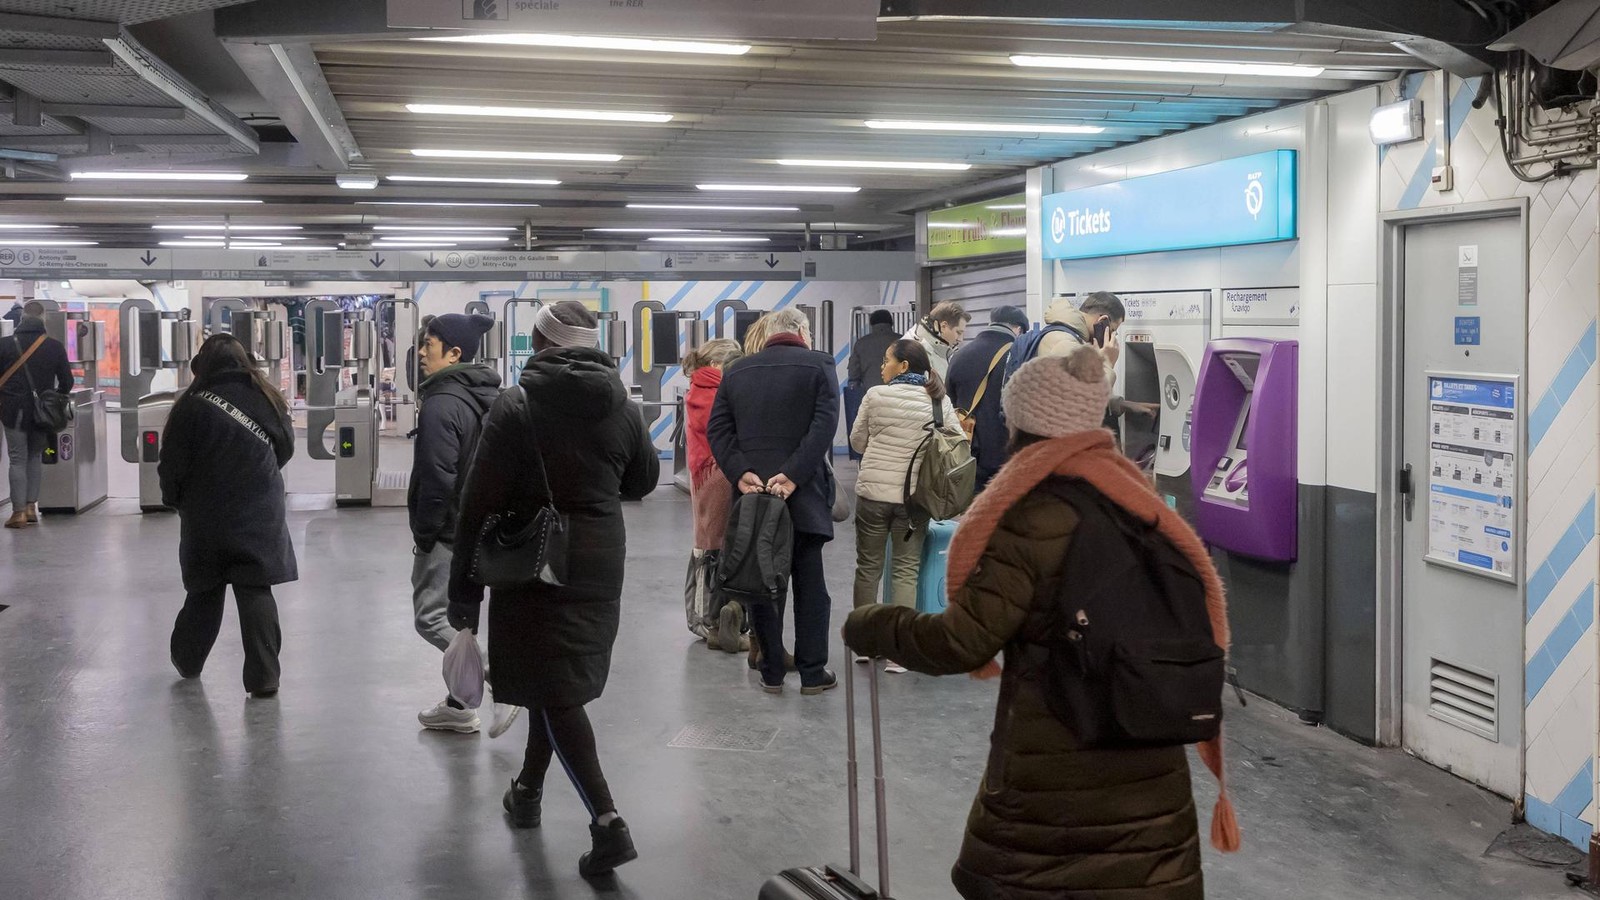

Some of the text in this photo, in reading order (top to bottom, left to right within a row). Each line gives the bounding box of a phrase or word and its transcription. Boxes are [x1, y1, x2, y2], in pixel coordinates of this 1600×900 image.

[515, 0, 559, 10] spéciale
[1247, 171, 1262, 180] RATP
[1068, 207, 1111, 236] Tickets
[1124, 298, 1140, 307] Tickets
[1226, 292, 1267, 304] Rechargement
[230, 407, 270, 445] BIMBAYLOLA
